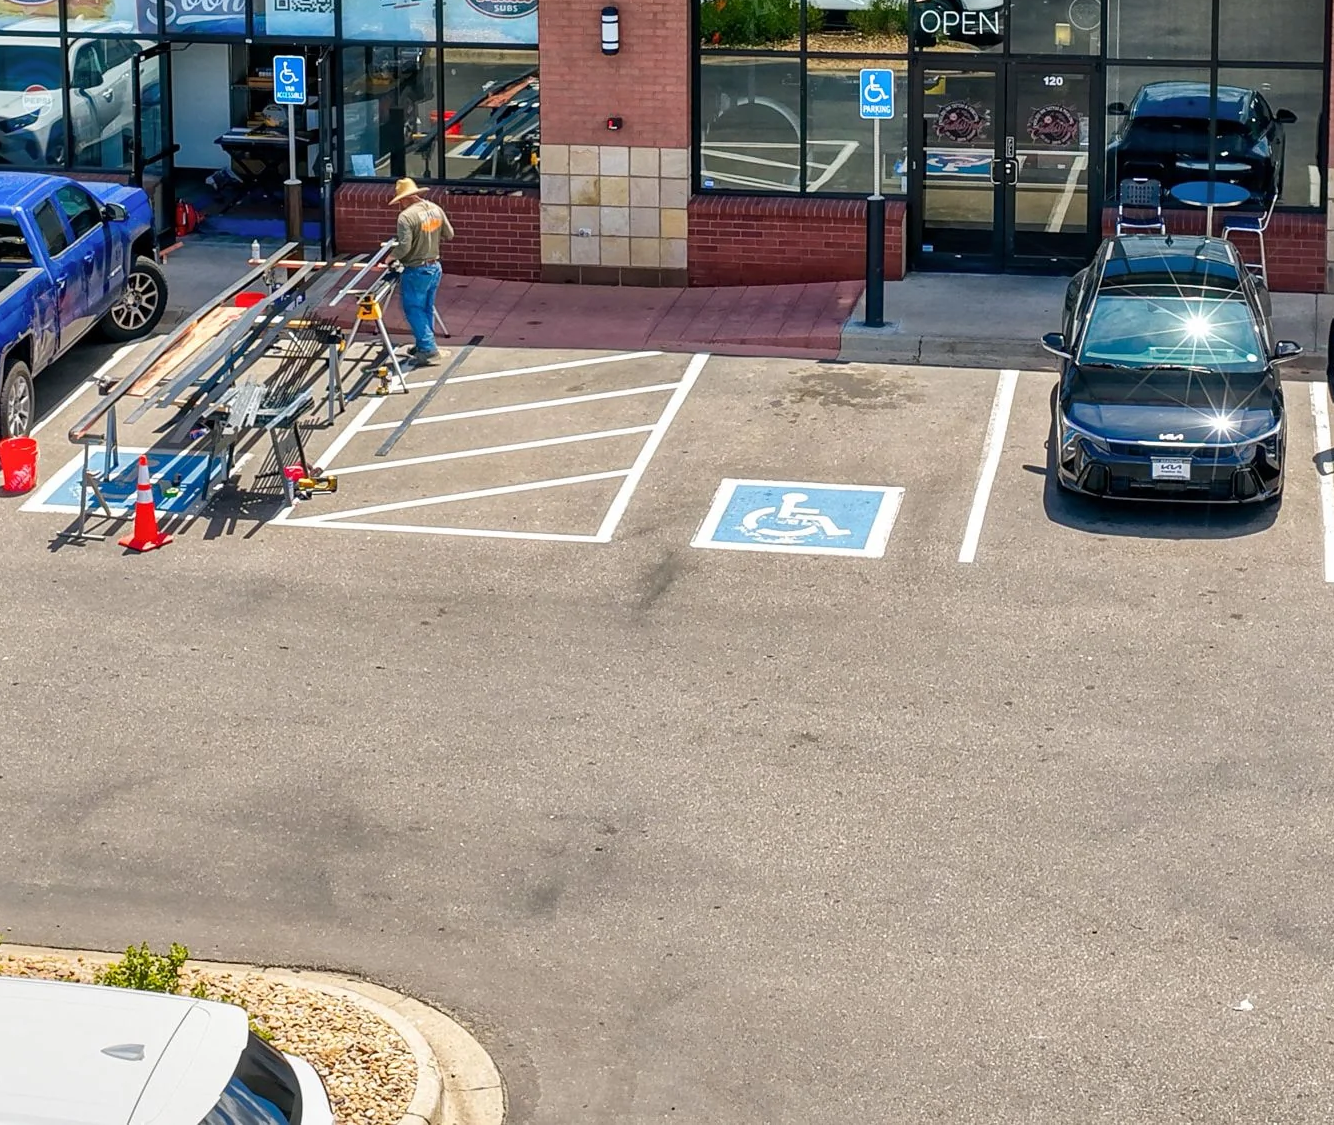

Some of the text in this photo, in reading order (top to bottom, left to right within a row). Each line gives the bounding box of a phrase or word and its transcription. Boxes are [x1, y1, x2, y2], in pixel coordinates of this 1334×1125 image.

[493, 4, 519, 12] SUBS
[920, 10, 999, 35] OPEN
[1043, 76, 1064, 86] 120
[862, 105, 891, 114] PARKING
